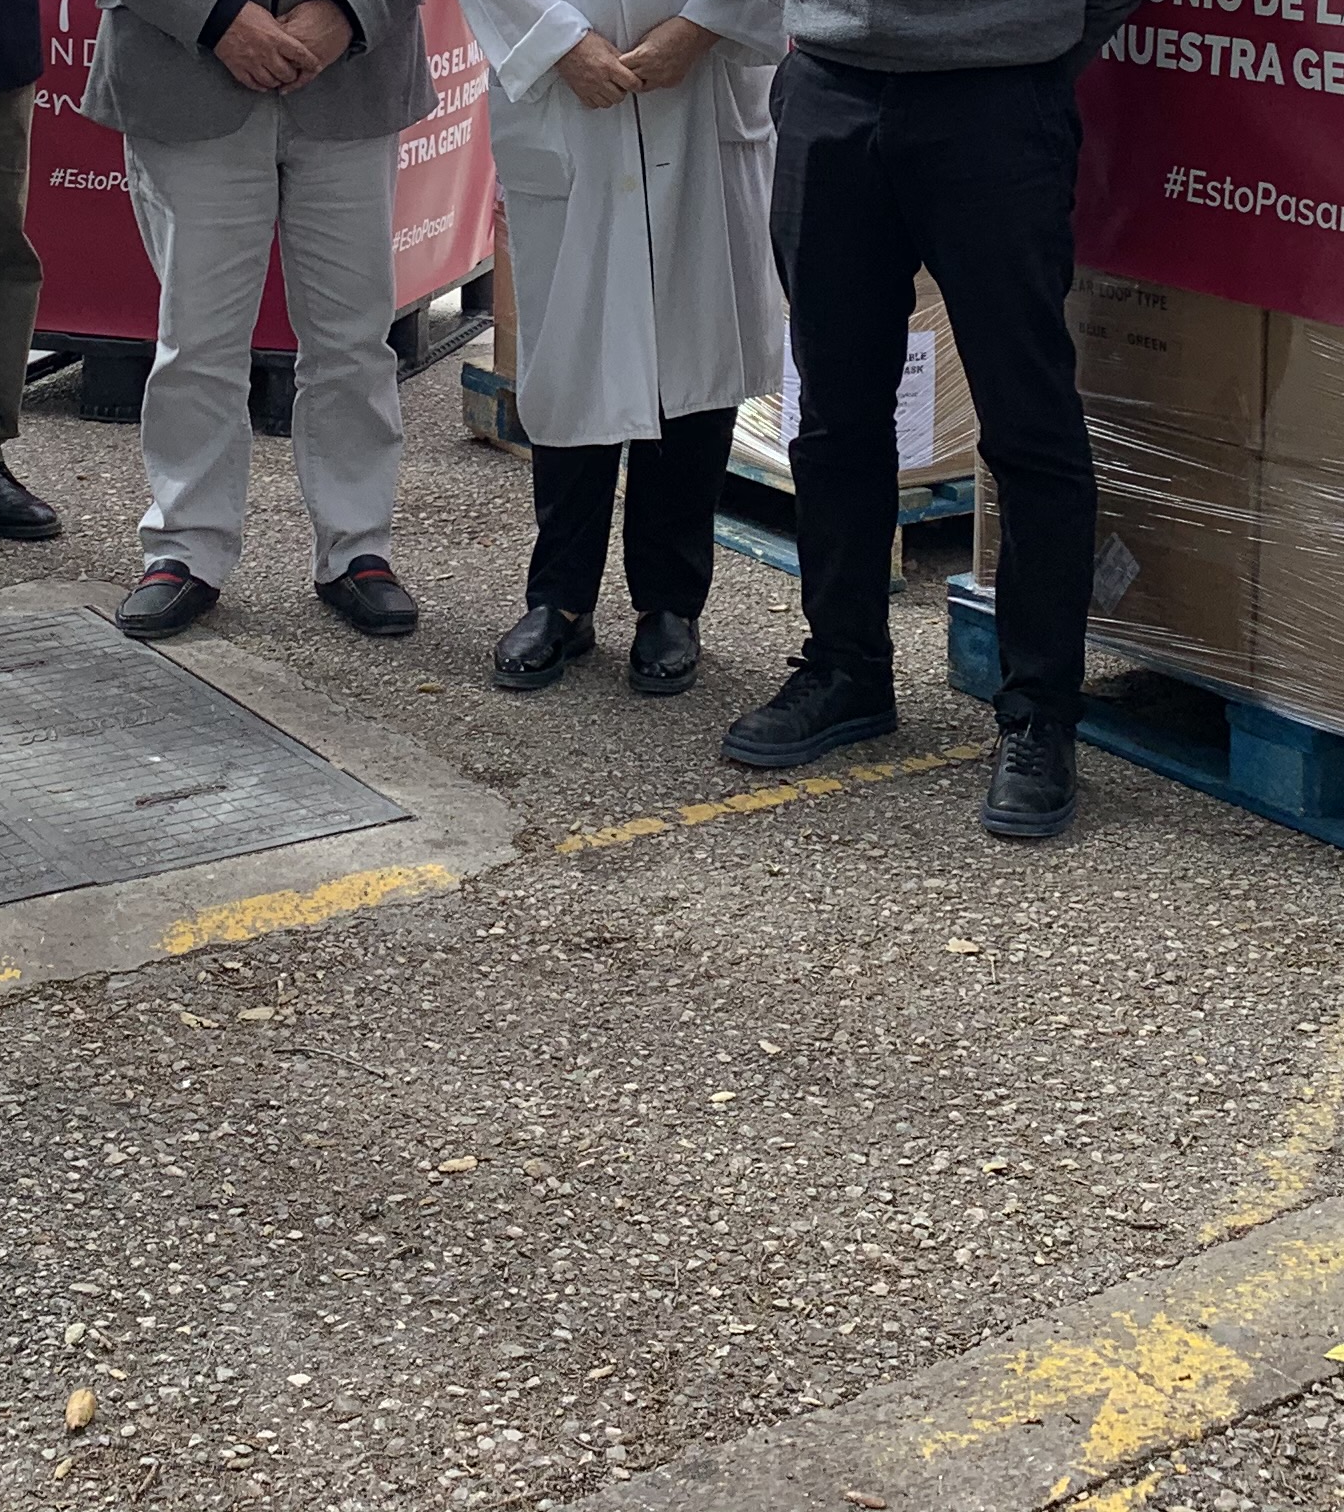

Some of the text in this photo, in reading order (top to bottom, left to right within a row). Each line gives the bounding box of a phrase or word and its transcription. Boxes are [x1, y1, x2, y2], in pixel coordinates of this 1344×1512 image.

[1100, 23, 1285, 88] NUESTRA
[1136, 290, 1168, 311] TYPE
[1127, 333, 1167, 353] GREEN
